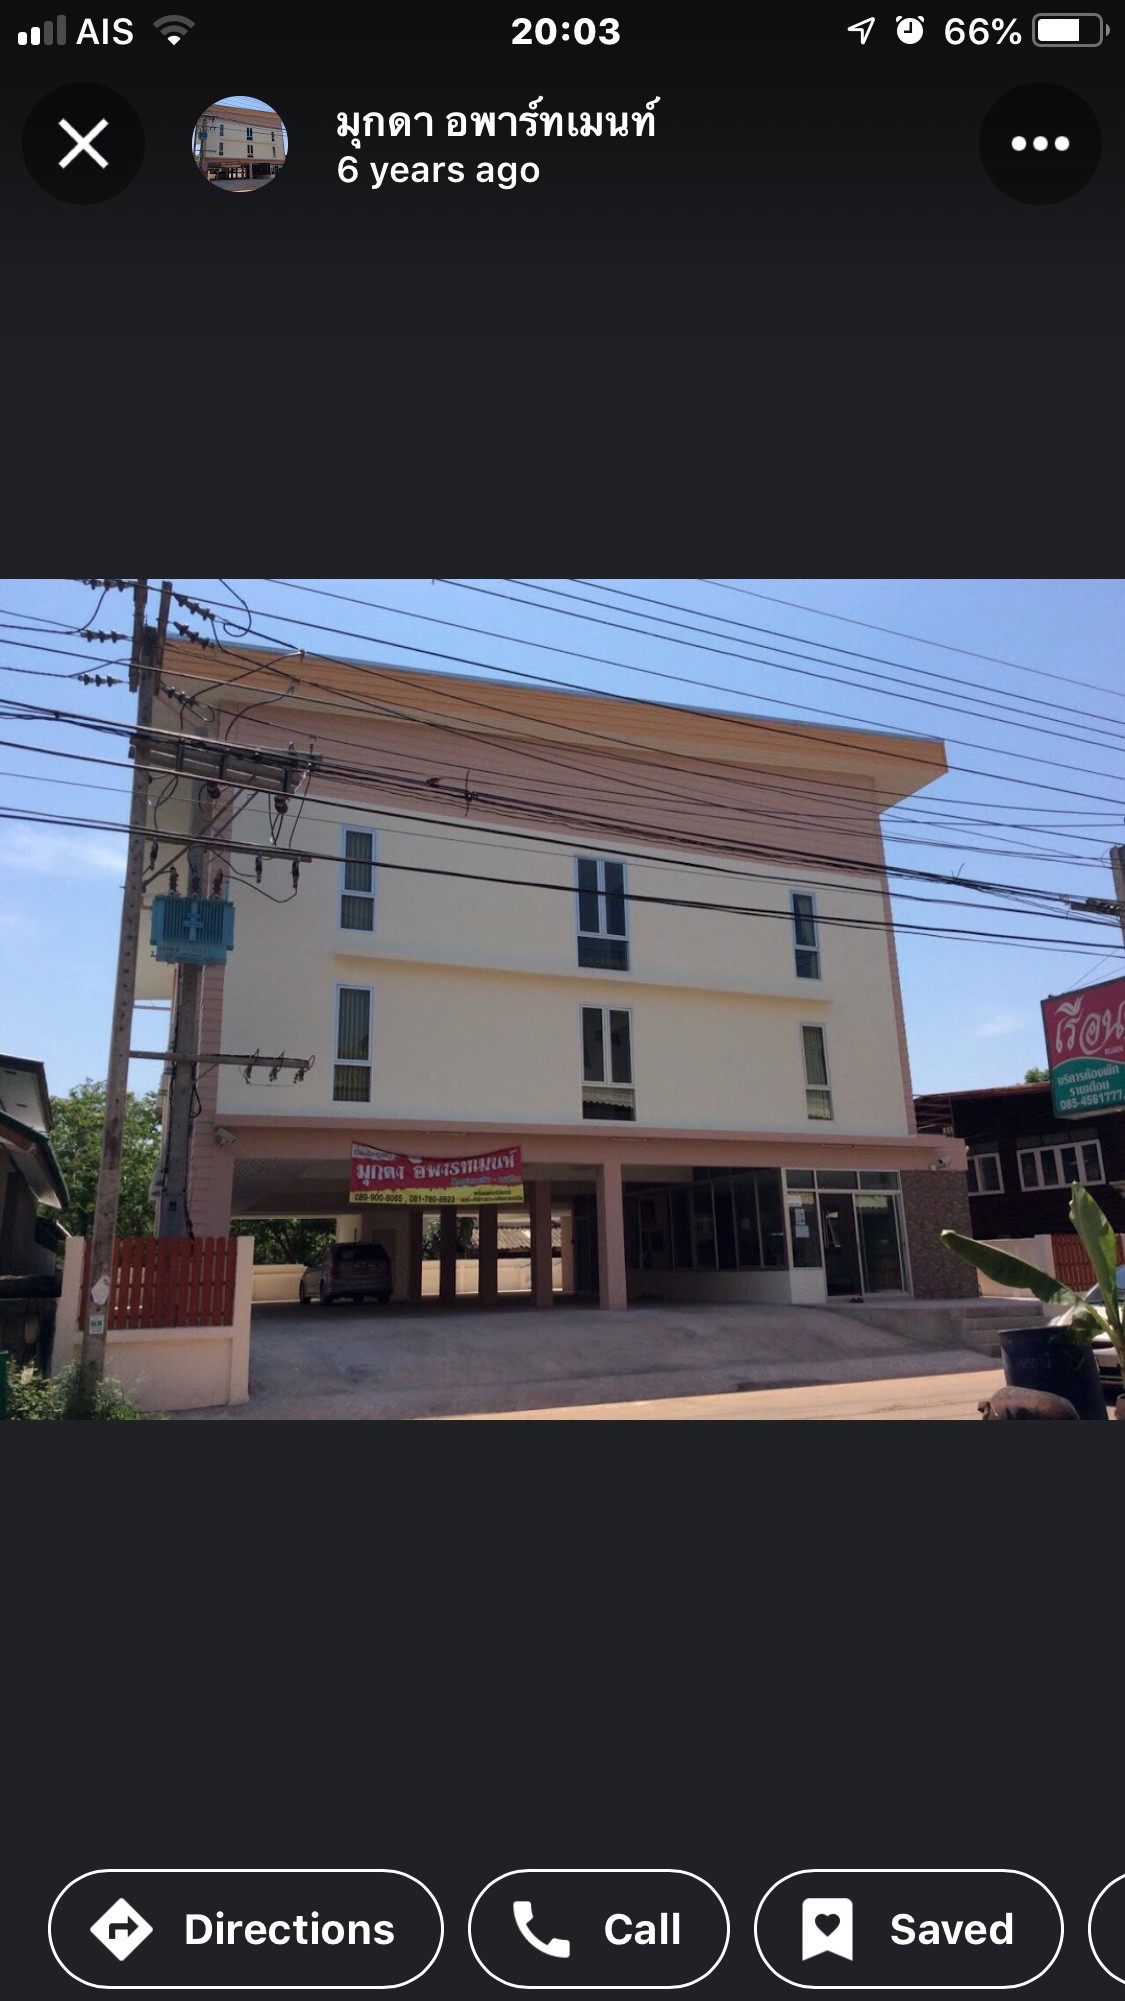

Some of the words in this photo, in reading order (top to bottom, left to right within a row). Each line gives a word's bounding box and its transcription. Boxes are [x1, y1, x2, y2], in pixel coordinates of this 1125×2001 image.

[1069, 1080, 1110, 1096] รายเดือน
[356, 1164, 405, 1187] มุกดา
